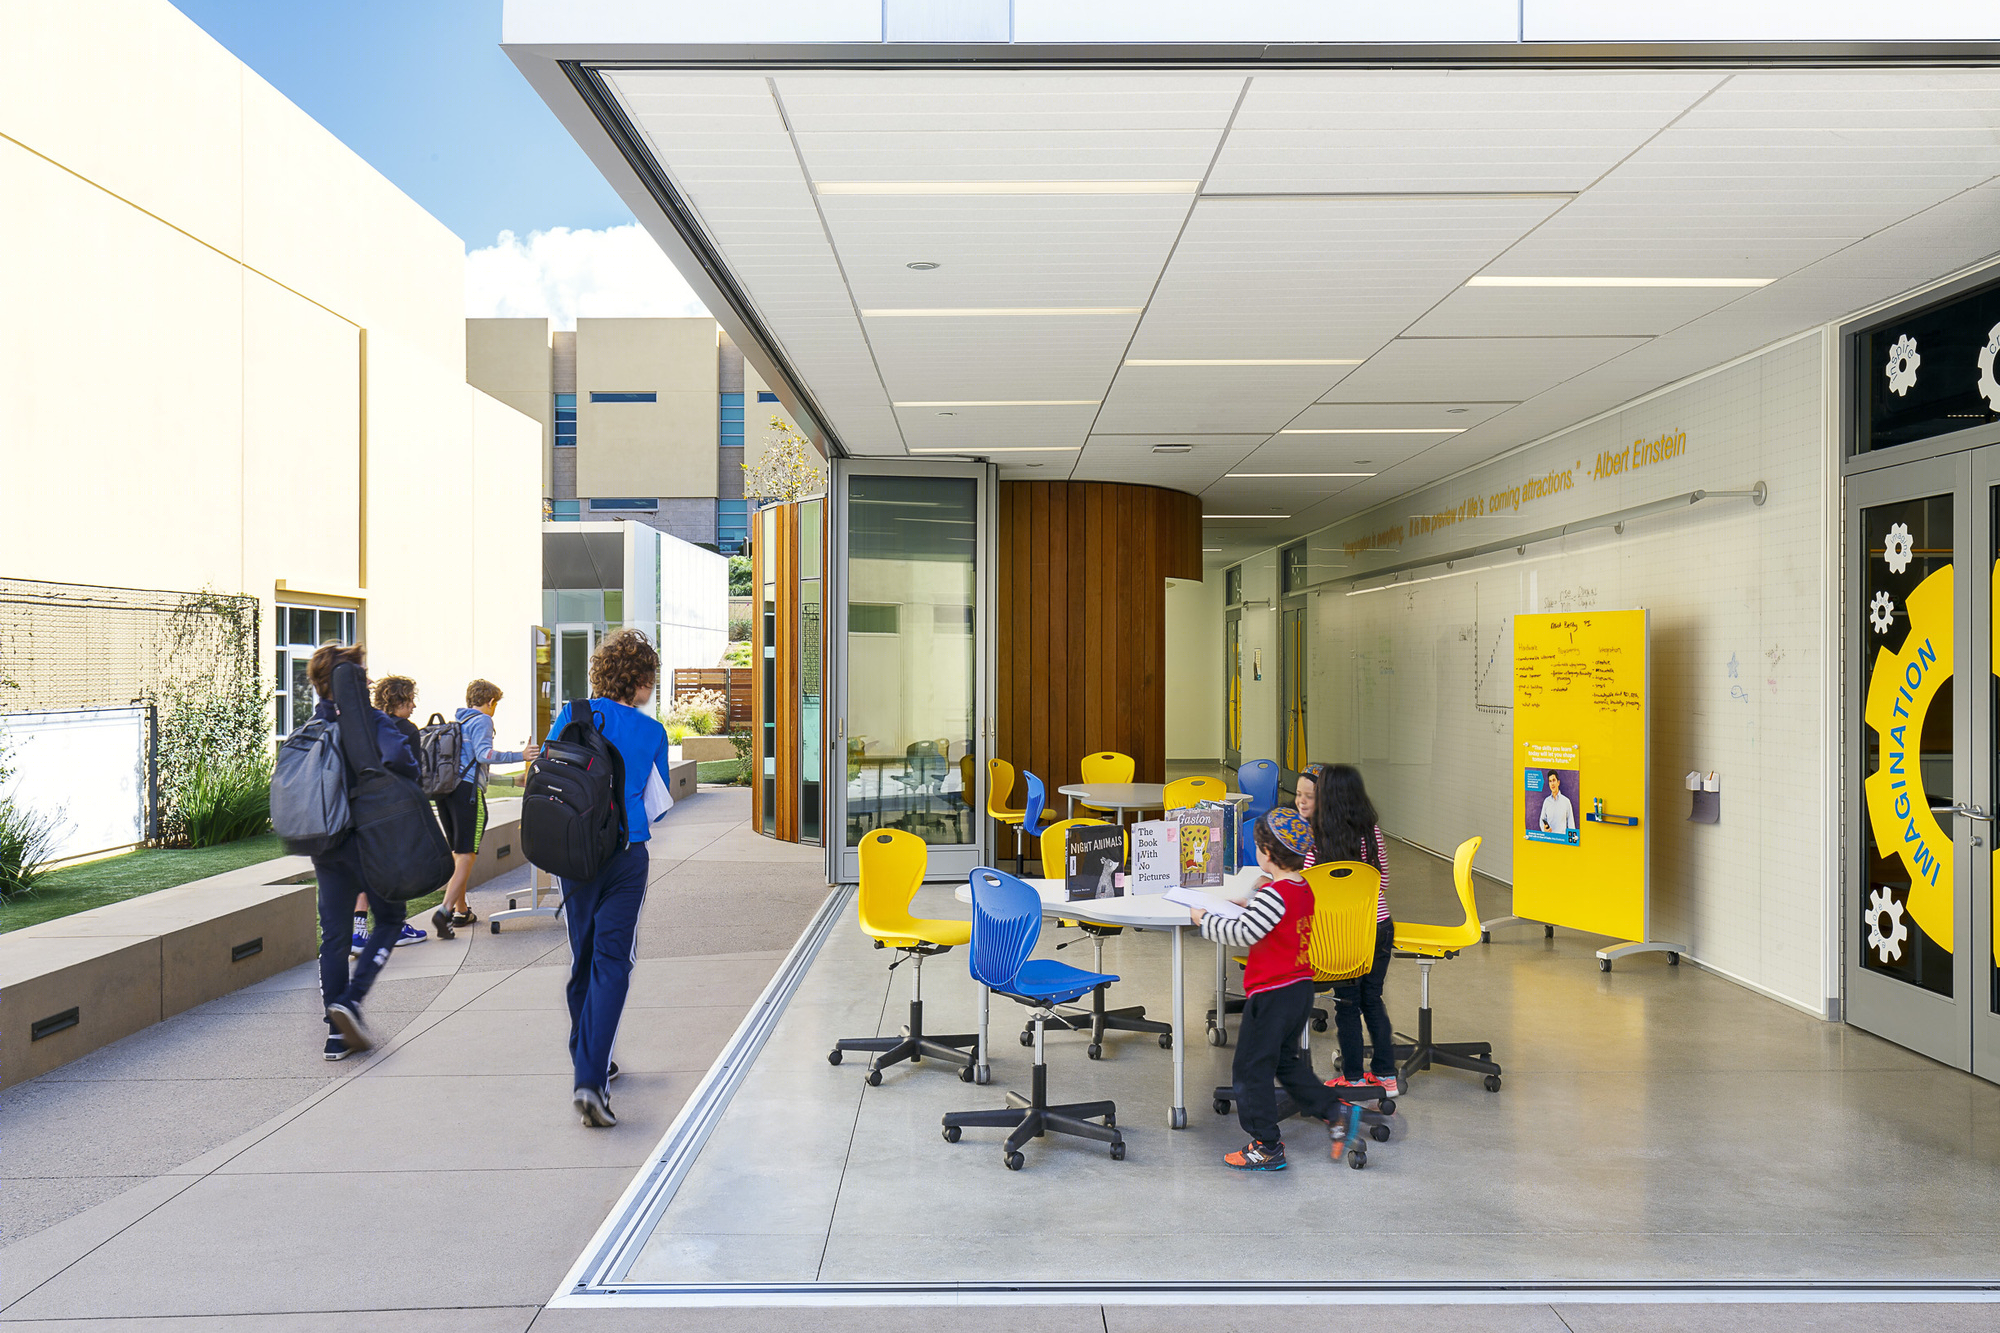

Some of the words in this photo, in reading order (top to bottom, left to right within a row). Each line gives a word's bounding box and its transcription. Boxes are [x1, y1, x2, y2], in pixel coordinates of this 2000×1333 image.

[1890, 340, 1914, 384] inspire
[1431, 505, 1457, 536] preview
[1458, 499, 1466, 523] of
[1467, 494, 1484, 520] life's
[1489, 484, 1520, 513] coming
[1593, 445, 1630, 481] Albert
[1632, 427, 1686, 470] Einstein
[1890, 532, 1907, 558] imagine
[1889, 638, 1941, 887] IMAGINATION
[1177, 813, 1212, 825] Gaston
[1137, 827, 1154, 836] The
[1070, 841, 1093, 855] NIGHT
[1093, 835, 1123, 851] ANIMALS
[1138, 838, 1158, 848] Book
[1138, 862, 1151, 871] No
[1138, 873, 1171, 882] Pictures
[1872, 903, 1887, 949] explore
